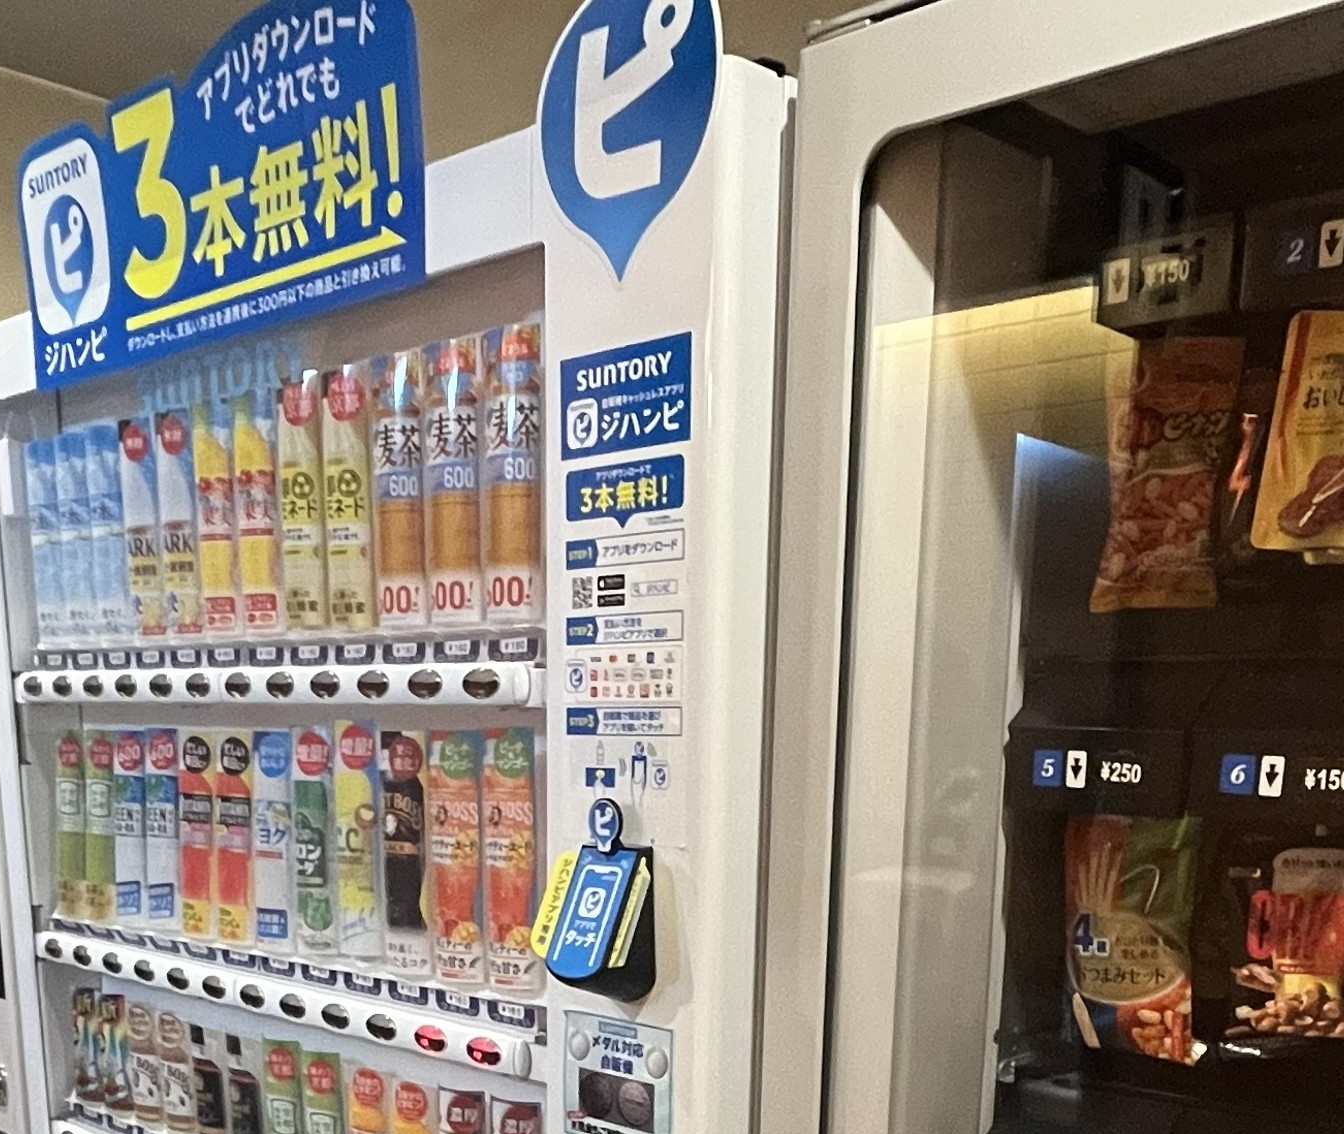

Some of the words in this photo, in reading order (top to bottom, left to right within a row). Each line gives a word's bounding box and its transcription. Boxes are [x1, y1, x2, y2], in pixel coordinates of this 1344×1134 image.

[197, 0, 376, 120] アプリダウンロード
[234, 57, 340, 133] でどれでも
[27, 152, 89, 199] SUNTORY
[1286, 237, 1306, 263] 2
[44, 326, 108, 376] ジハンピ
[576, 351, 672, 392] SUNTORY
[432, 412, 478, 460] 麦茶
[490, 401, 540, 450] 麦茶
[601, 399, 685, 441] ジハンピ
[378, 424, 421, 470] 麦茶
[389, 474, 418, 497] 600
[442, 466, 475, 489] 600
[503, 457, 537, 480] 600
[580, 475, 668, 513] 3本無料!
[1040, 759, 1055, 777] 5
[1100, 762, 1142, 783] ¥250
[1229, 764, 1246, 784] 6
[565, 930, 596, 948] タッチ
[592, 1035, 644, 1059] メタル対応
